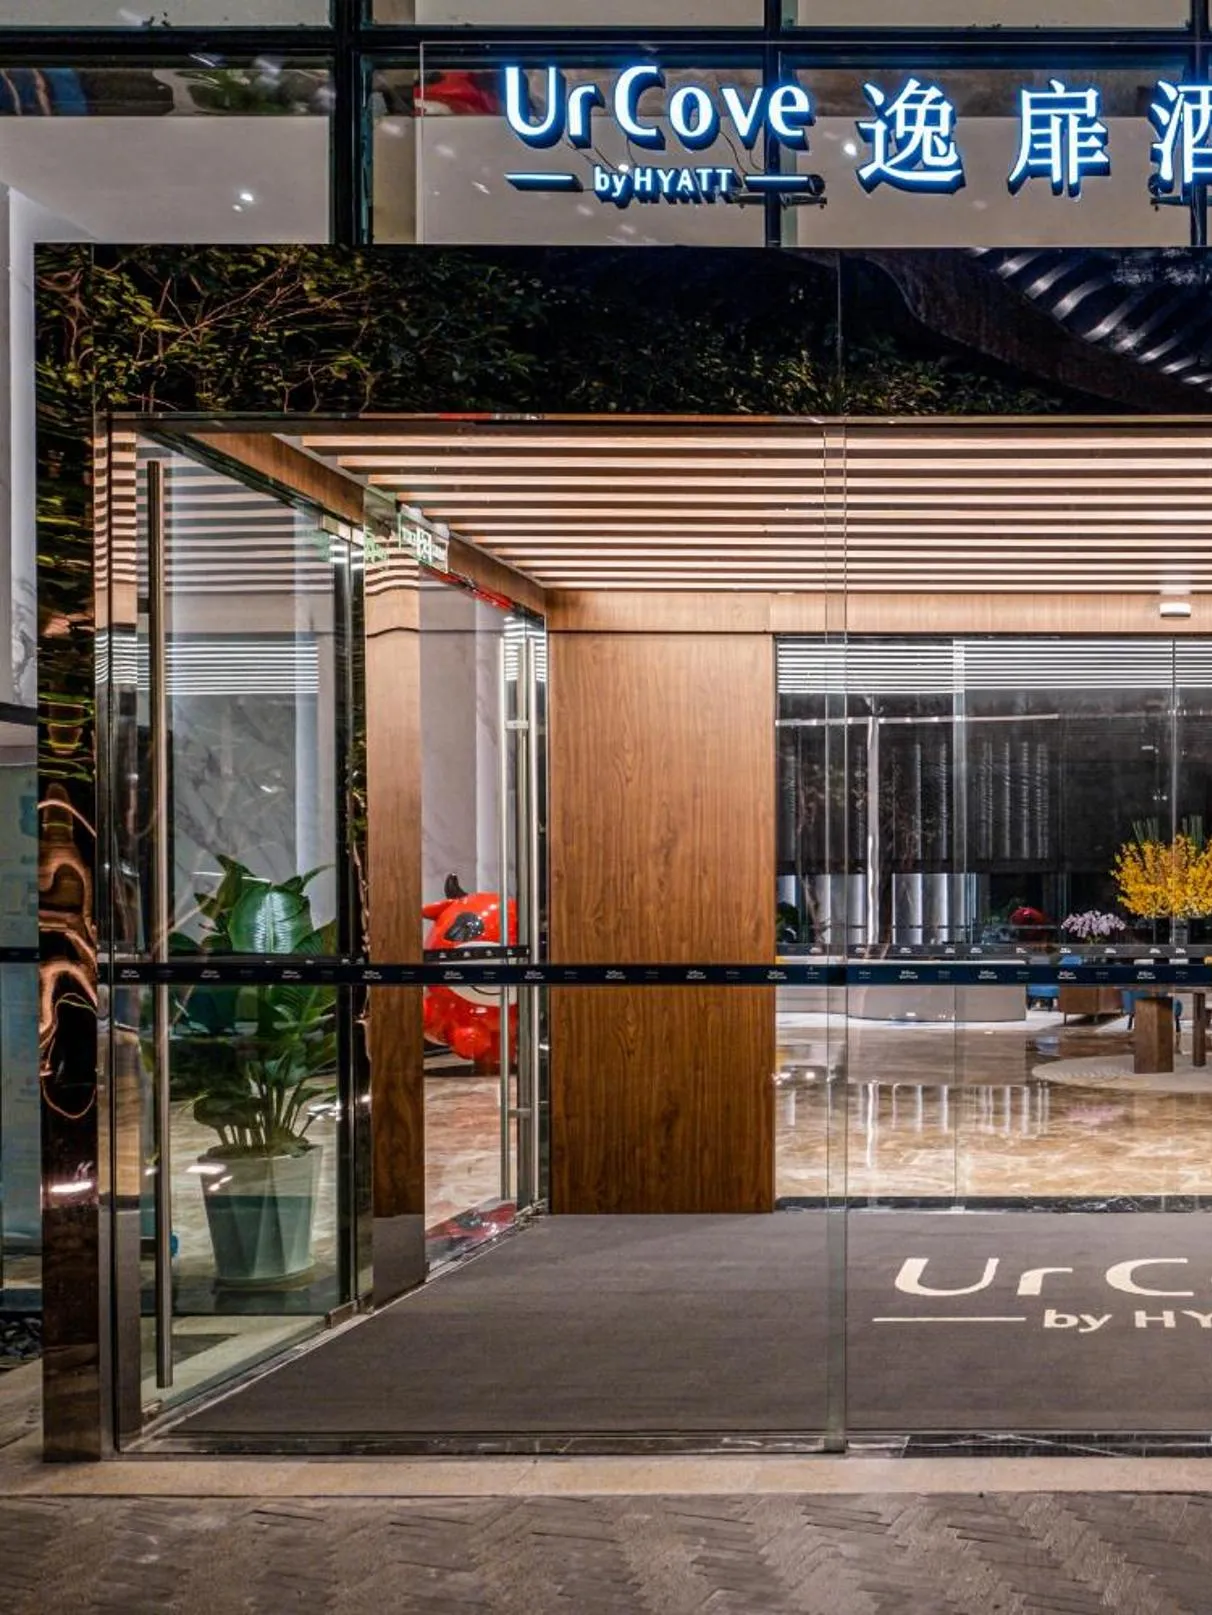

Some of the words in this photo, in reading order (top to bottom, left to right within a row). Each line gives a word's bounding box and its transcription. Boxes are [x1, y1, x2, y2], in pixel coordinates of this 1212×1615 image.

[504, 65, 812, 143] UrCove
[594, 166, 627, 197] by
[633, 167, 735, 195] HYATT
[1043, 1309, 1112, 1333] by
